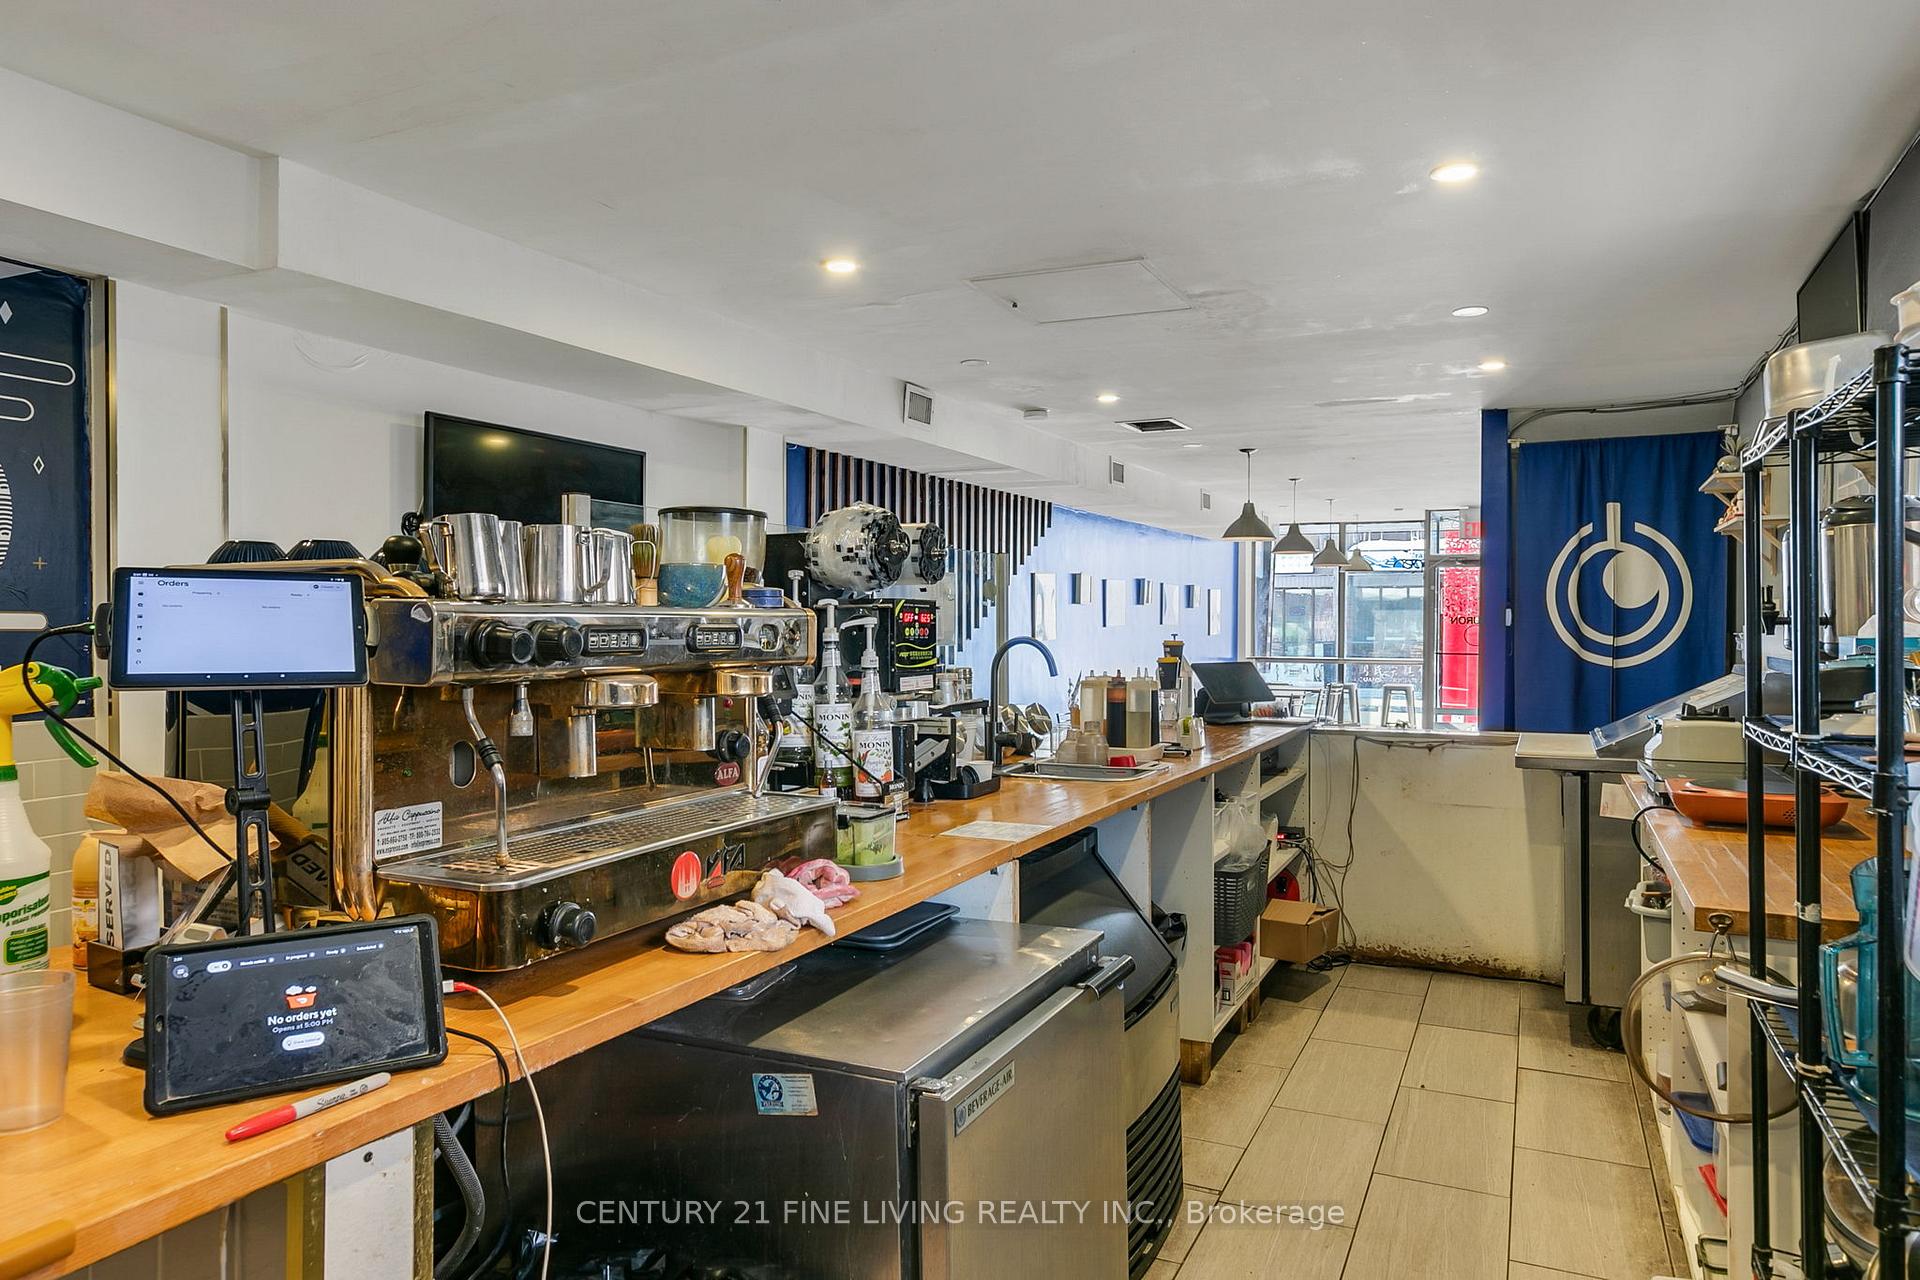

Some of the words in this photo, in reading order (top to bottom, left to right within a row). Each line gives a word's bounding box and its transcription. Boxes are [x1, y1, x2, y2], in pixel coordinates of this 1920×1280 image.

[157, 579, 189, 587] Orders
[819, 713, 850, 721] MONIN
[859, 741, 891, 749] MONIN
[717, 767, 739, 780] ALFA
[104, 848, 115, 947] SERVED
[267, 1016, 284, 1026] No
[285, 1011, 319, 1023] orders
[320, 1007, 337, 1019] yet
[272, 1025, 295, 1033] Opens
[321, 1018, 334, 1026] PM
[967, 1068, 1013, 1118] BEVERAGE-AIR
